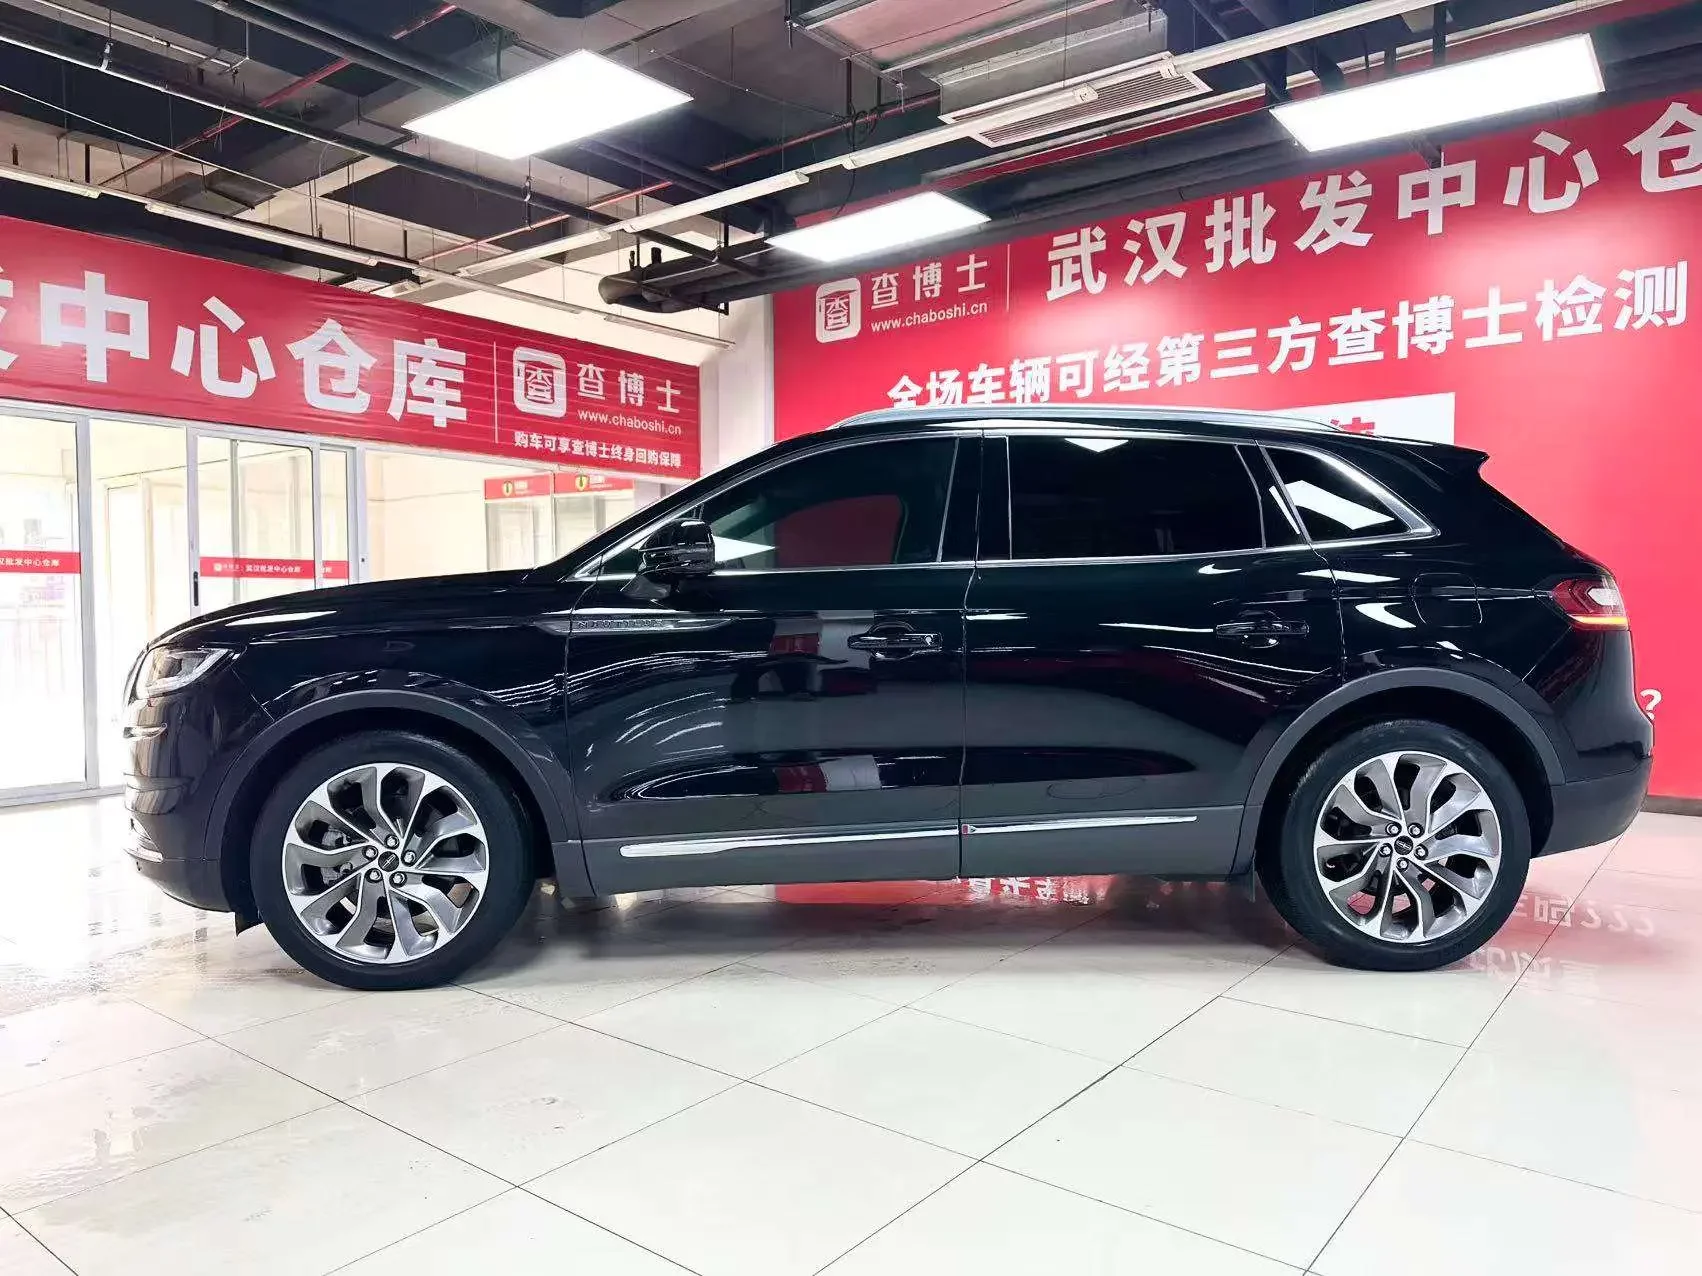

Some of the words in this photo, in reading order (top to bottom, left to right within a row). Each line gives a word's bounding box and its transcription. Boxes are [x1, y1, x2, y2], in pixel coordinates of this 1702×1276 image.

[1045, 102, 1702, 302] 武汉批发中心仓
[871, 254, 988, 310] 查博士
[871, 302, 988, 332] www.chaboshi.cn
[887, 261, 1688, 408] 全场车辆可经第三方查博士检测
[577, 363, 681, 413] 查博士
[577, 409, 682, 436] www.chaboshi.cn
[514, 431, 682, 468] 购车可享查博士终身回购保障
